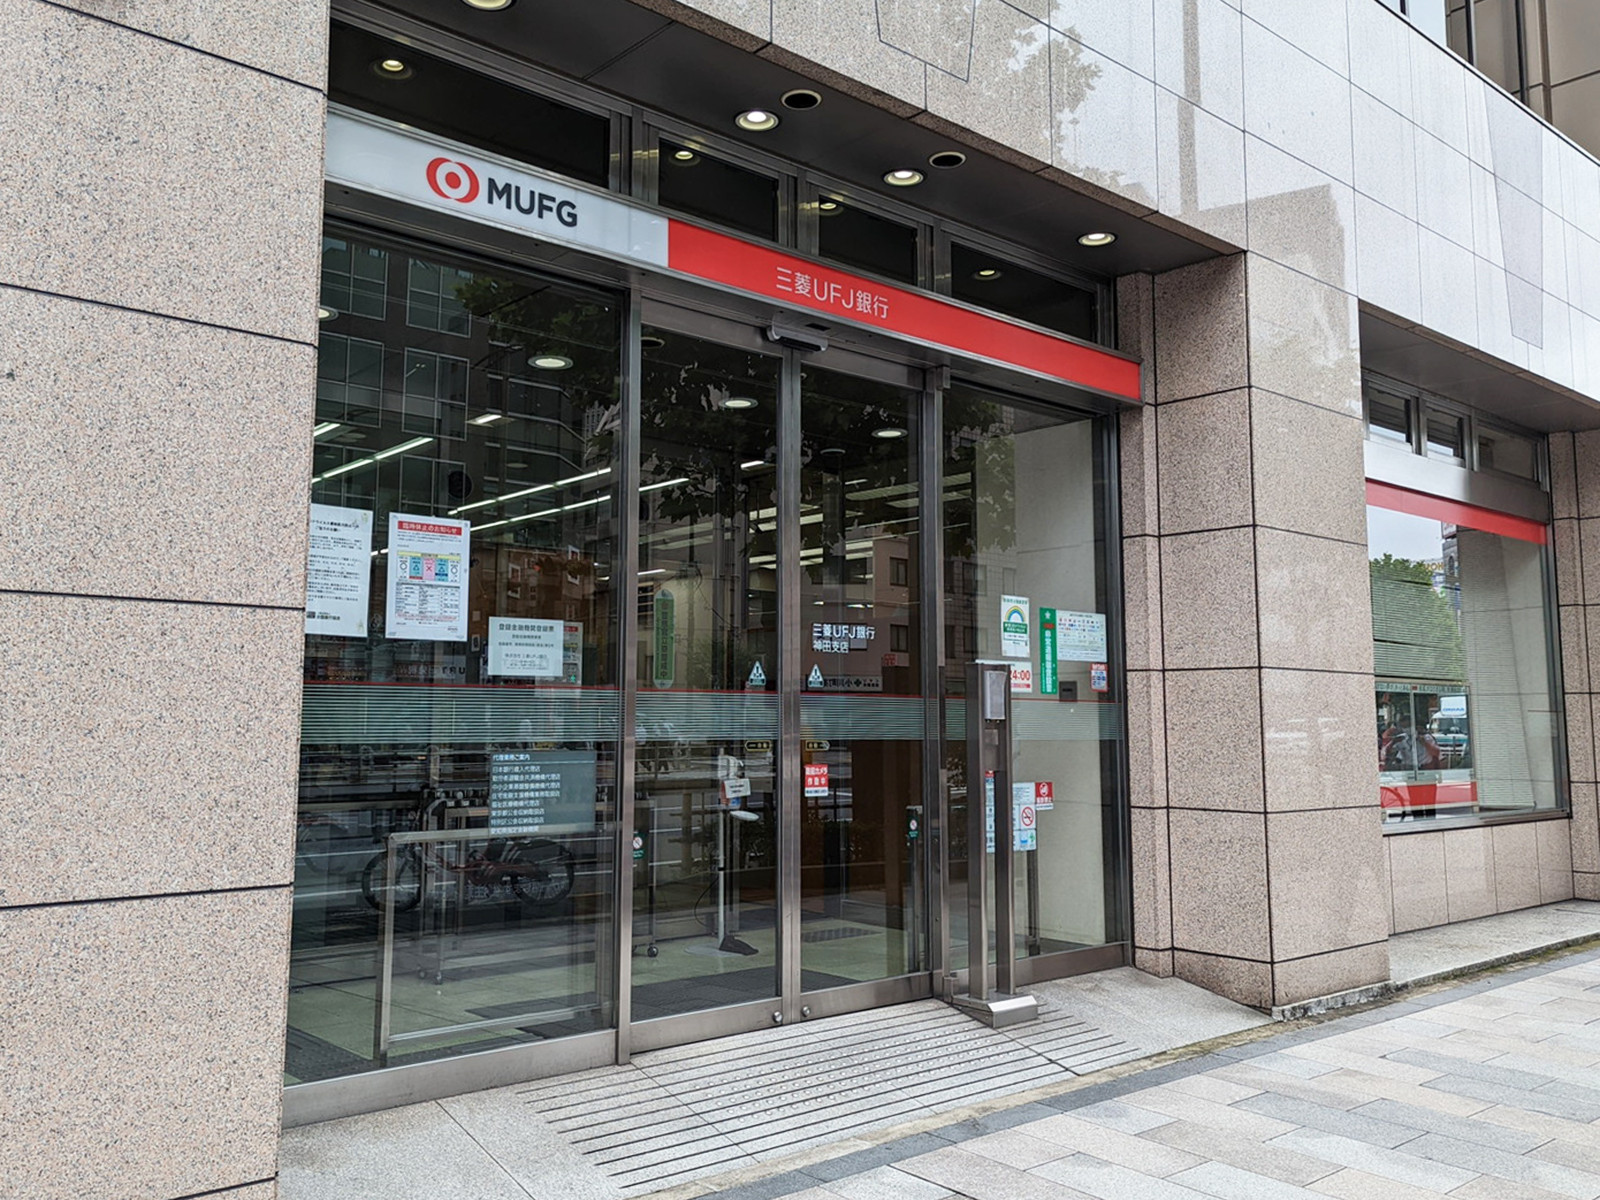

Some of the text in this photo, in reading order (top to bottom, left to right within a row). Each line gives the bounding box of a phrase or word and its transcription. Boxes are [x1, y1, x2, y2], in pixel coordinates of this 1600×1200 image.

[488, 177, 578, 228] MUFG
[775, 266, 889, 320] 三菱UFJ銀行
[402, 522, 457, 534] 臨時休止のお知らせ
[812, 623, 876, 640] 三菱UFJ銀行
[812, 640, 849, 654] 神田支店
